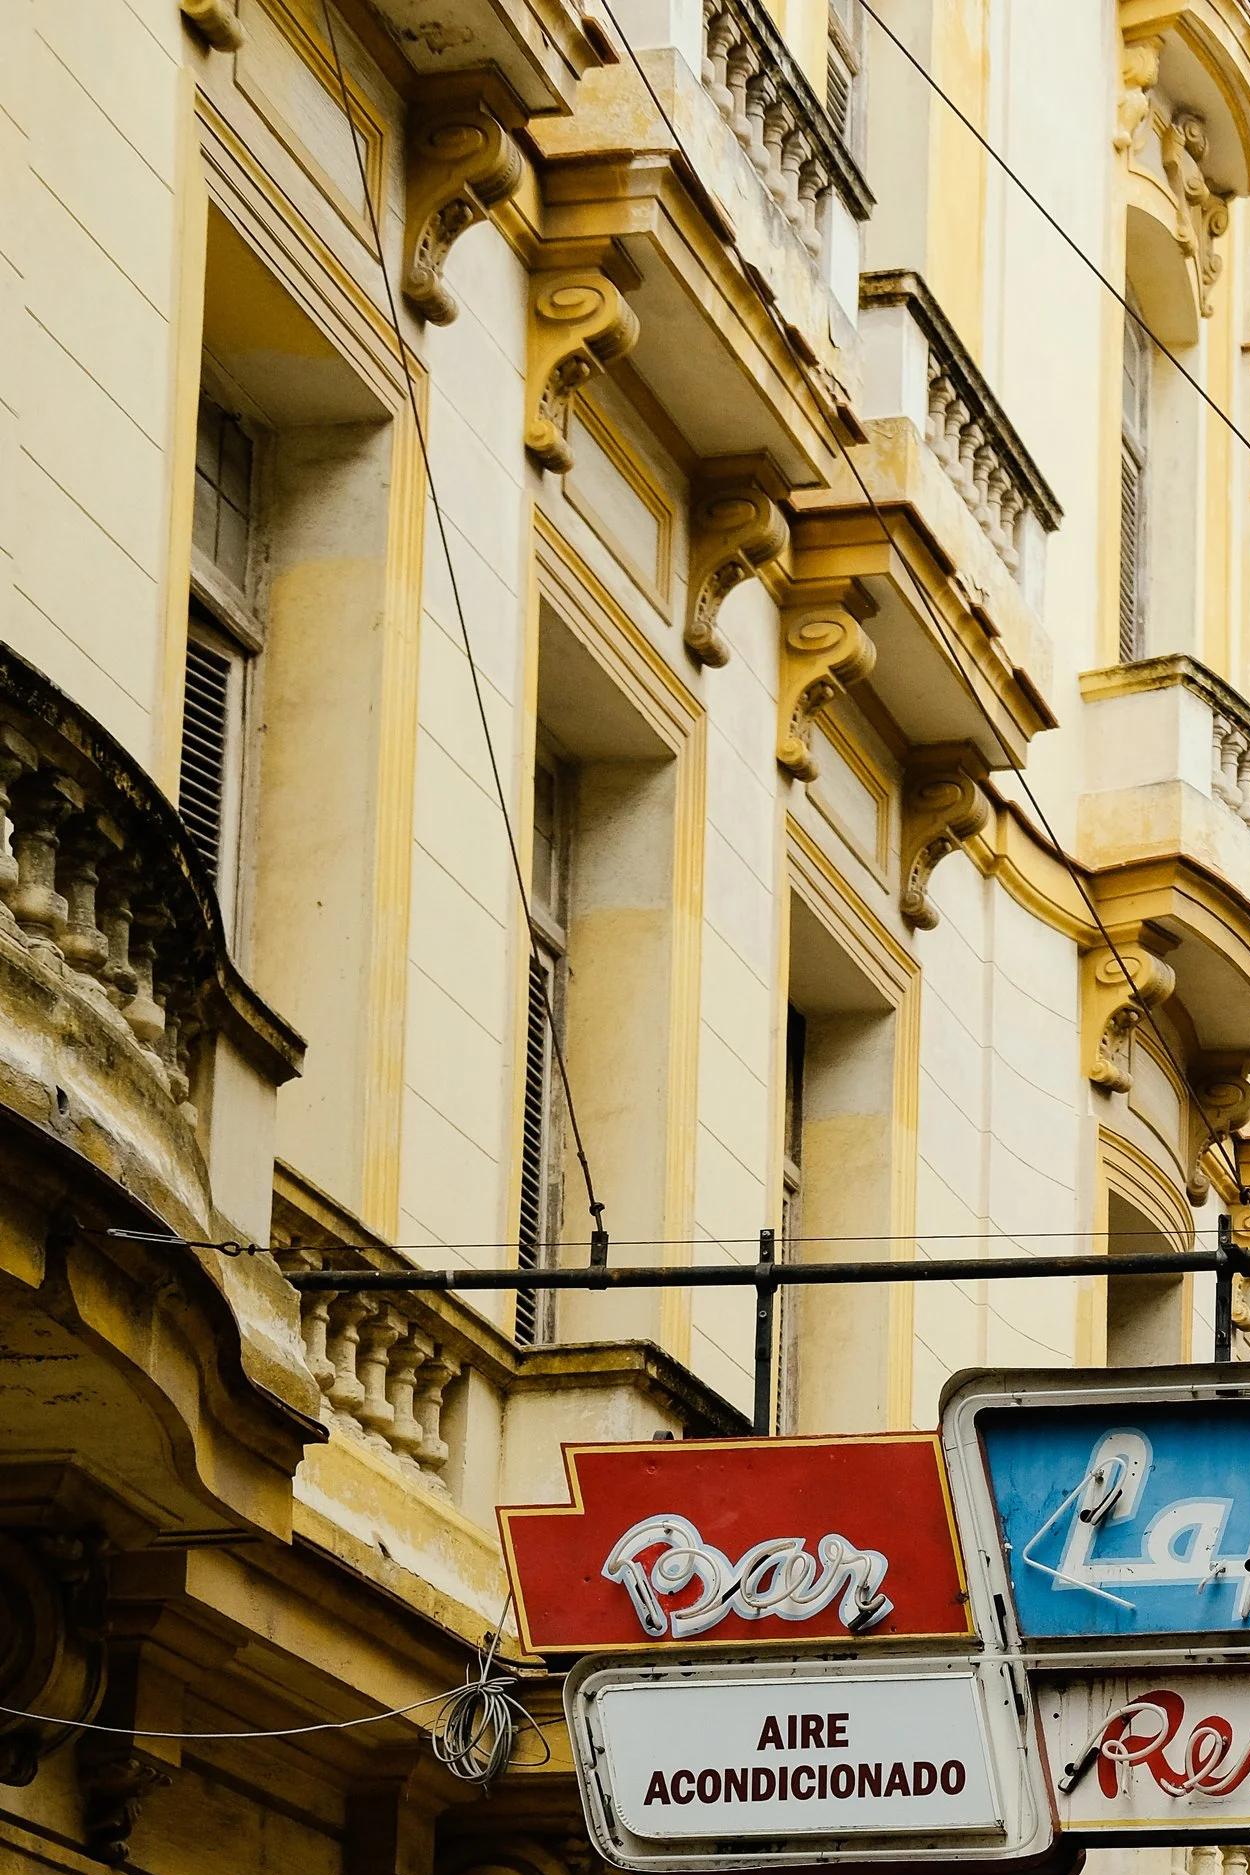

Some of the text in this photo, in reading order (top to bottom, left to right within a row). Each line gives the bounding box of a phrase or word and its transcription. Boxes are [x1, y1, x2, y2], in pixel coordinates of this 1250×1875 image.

[602, 1513, 895, 1639] Bar
[756, 1713, 850, 1750] AIRE
[643, 1761, 967, 1806] ACONDICIONADO
